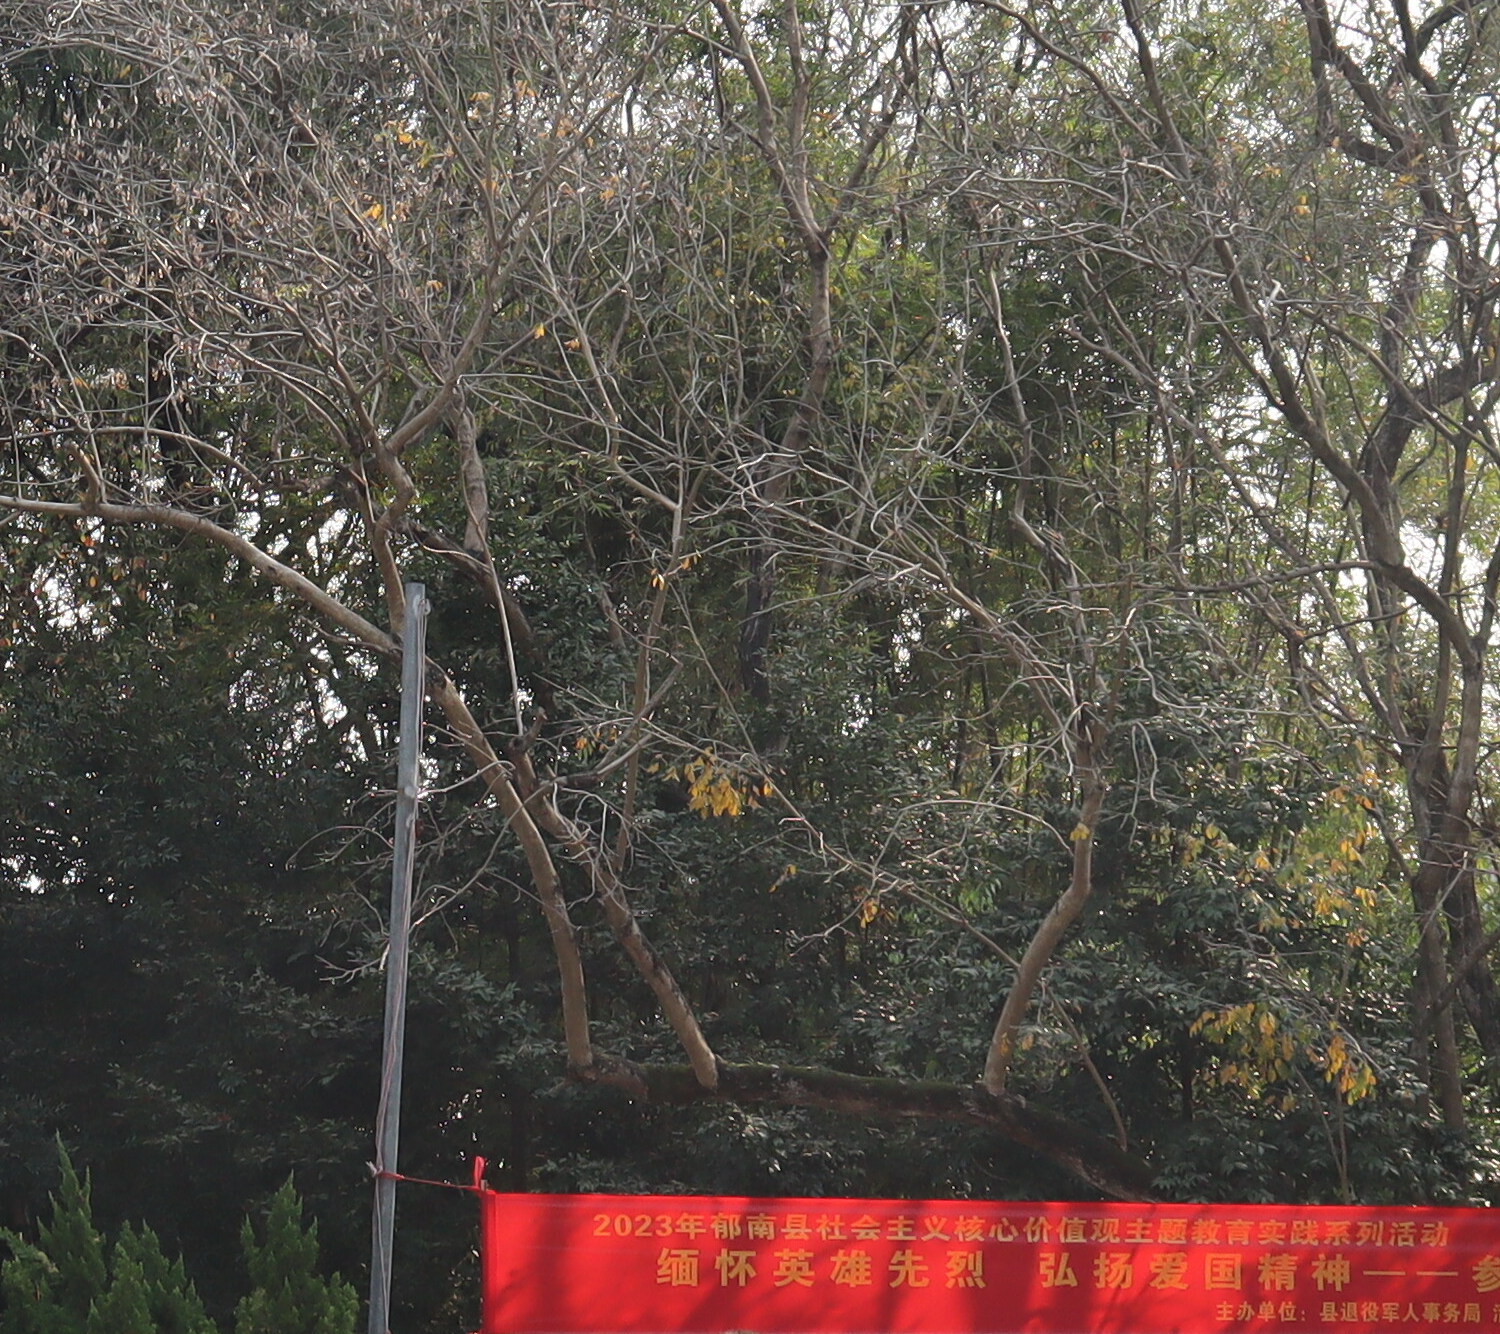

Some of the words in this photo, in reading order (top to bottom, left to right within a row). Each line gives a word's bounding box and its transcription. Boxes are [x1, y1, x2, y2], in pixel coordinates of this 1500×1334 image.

[592, 1212, 1450, 1248] 2023年郁南县社会主义核心价值观主题教育实践系列活动
[655, 1247, 987, 1289] 缅怀英雄先烈
